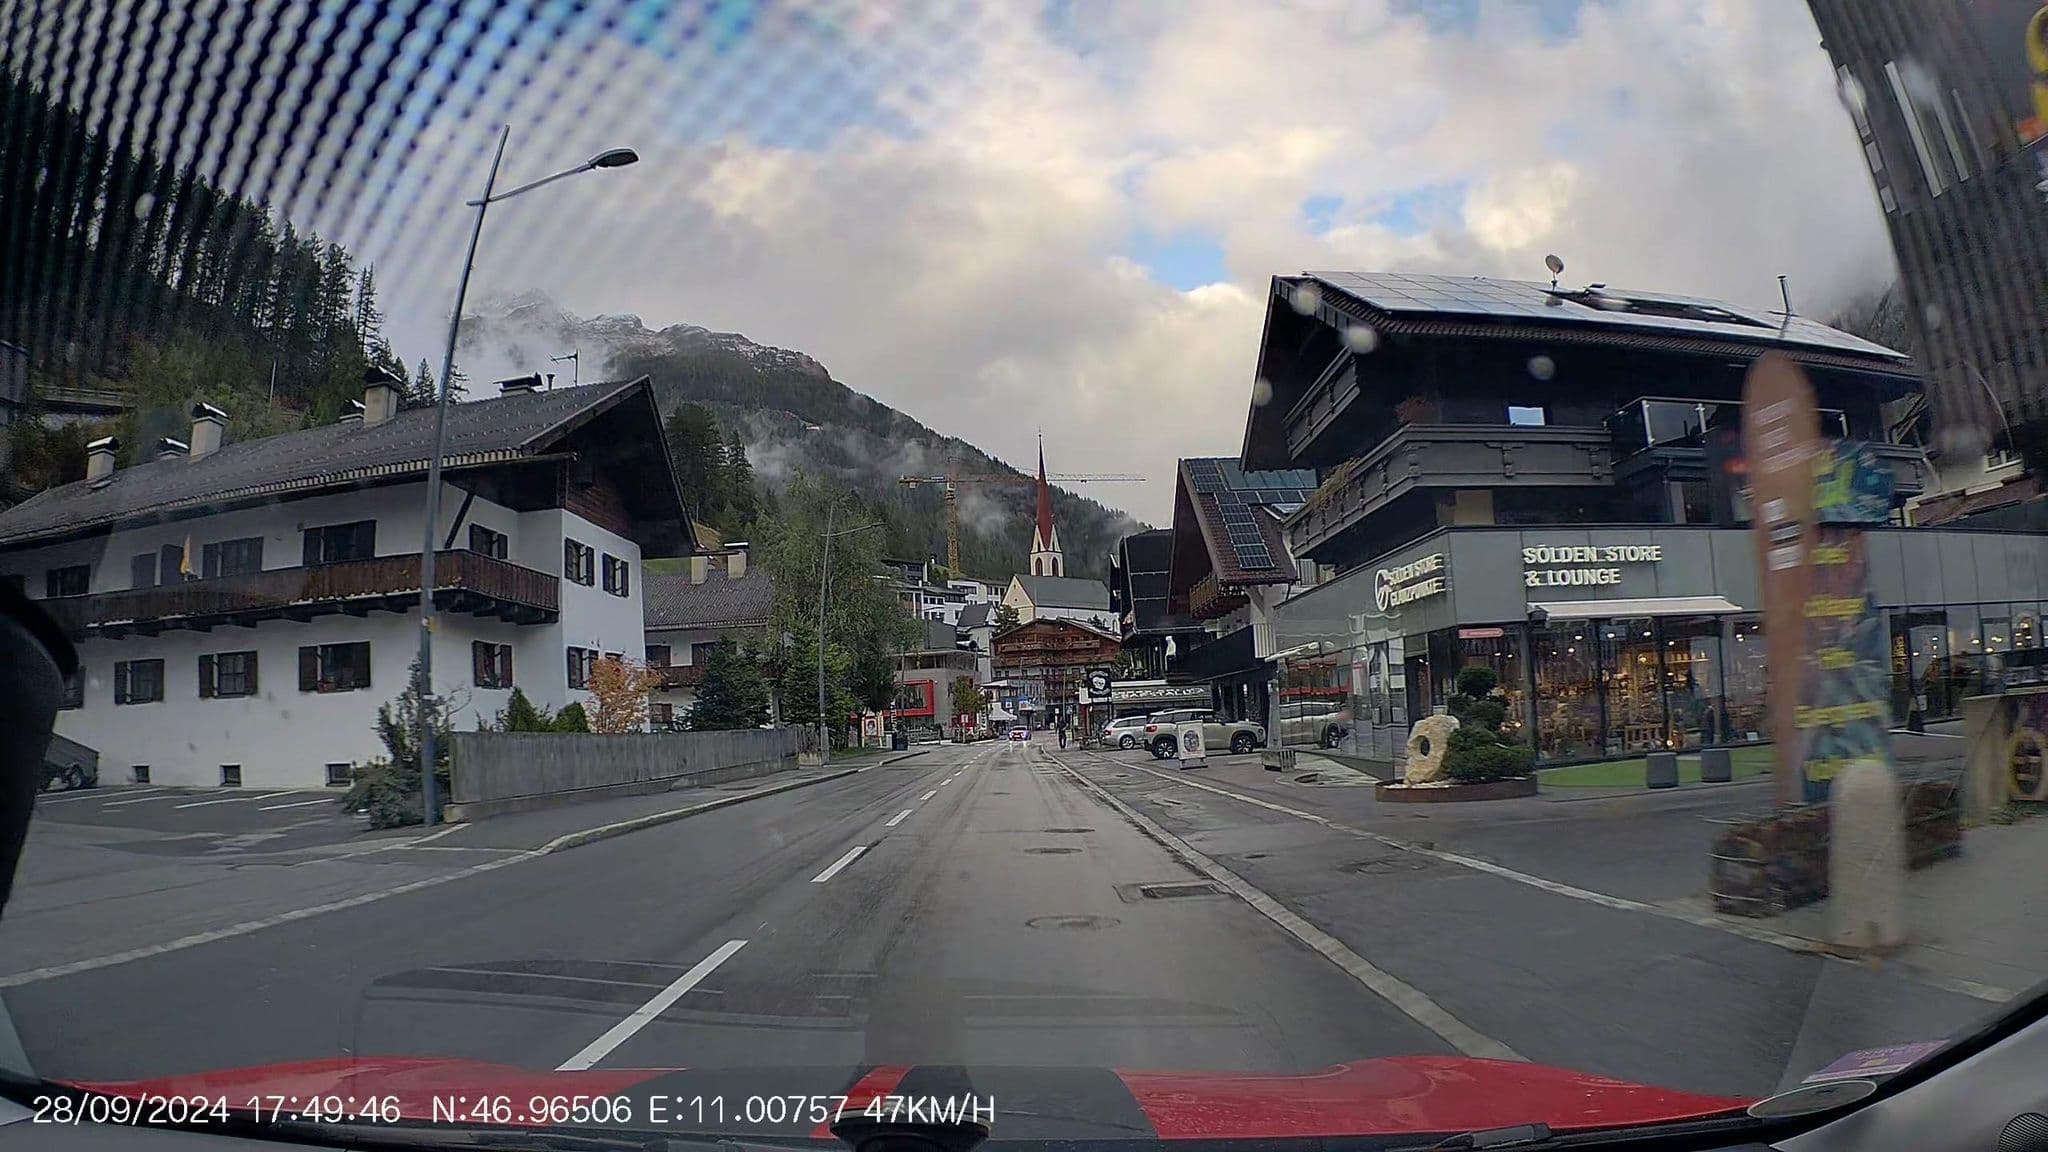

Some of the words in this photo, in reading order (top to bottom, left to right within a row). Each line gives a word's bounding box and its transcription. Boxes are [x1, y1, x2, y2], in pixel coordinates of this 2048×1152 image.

[1523, 544, 1597, 564] SÖLDEN
[1605, 545, 1662, 563] STORE
[1525, 570, 1544, 587] &
[1547, 568, 1621, 586] LOUNGE
